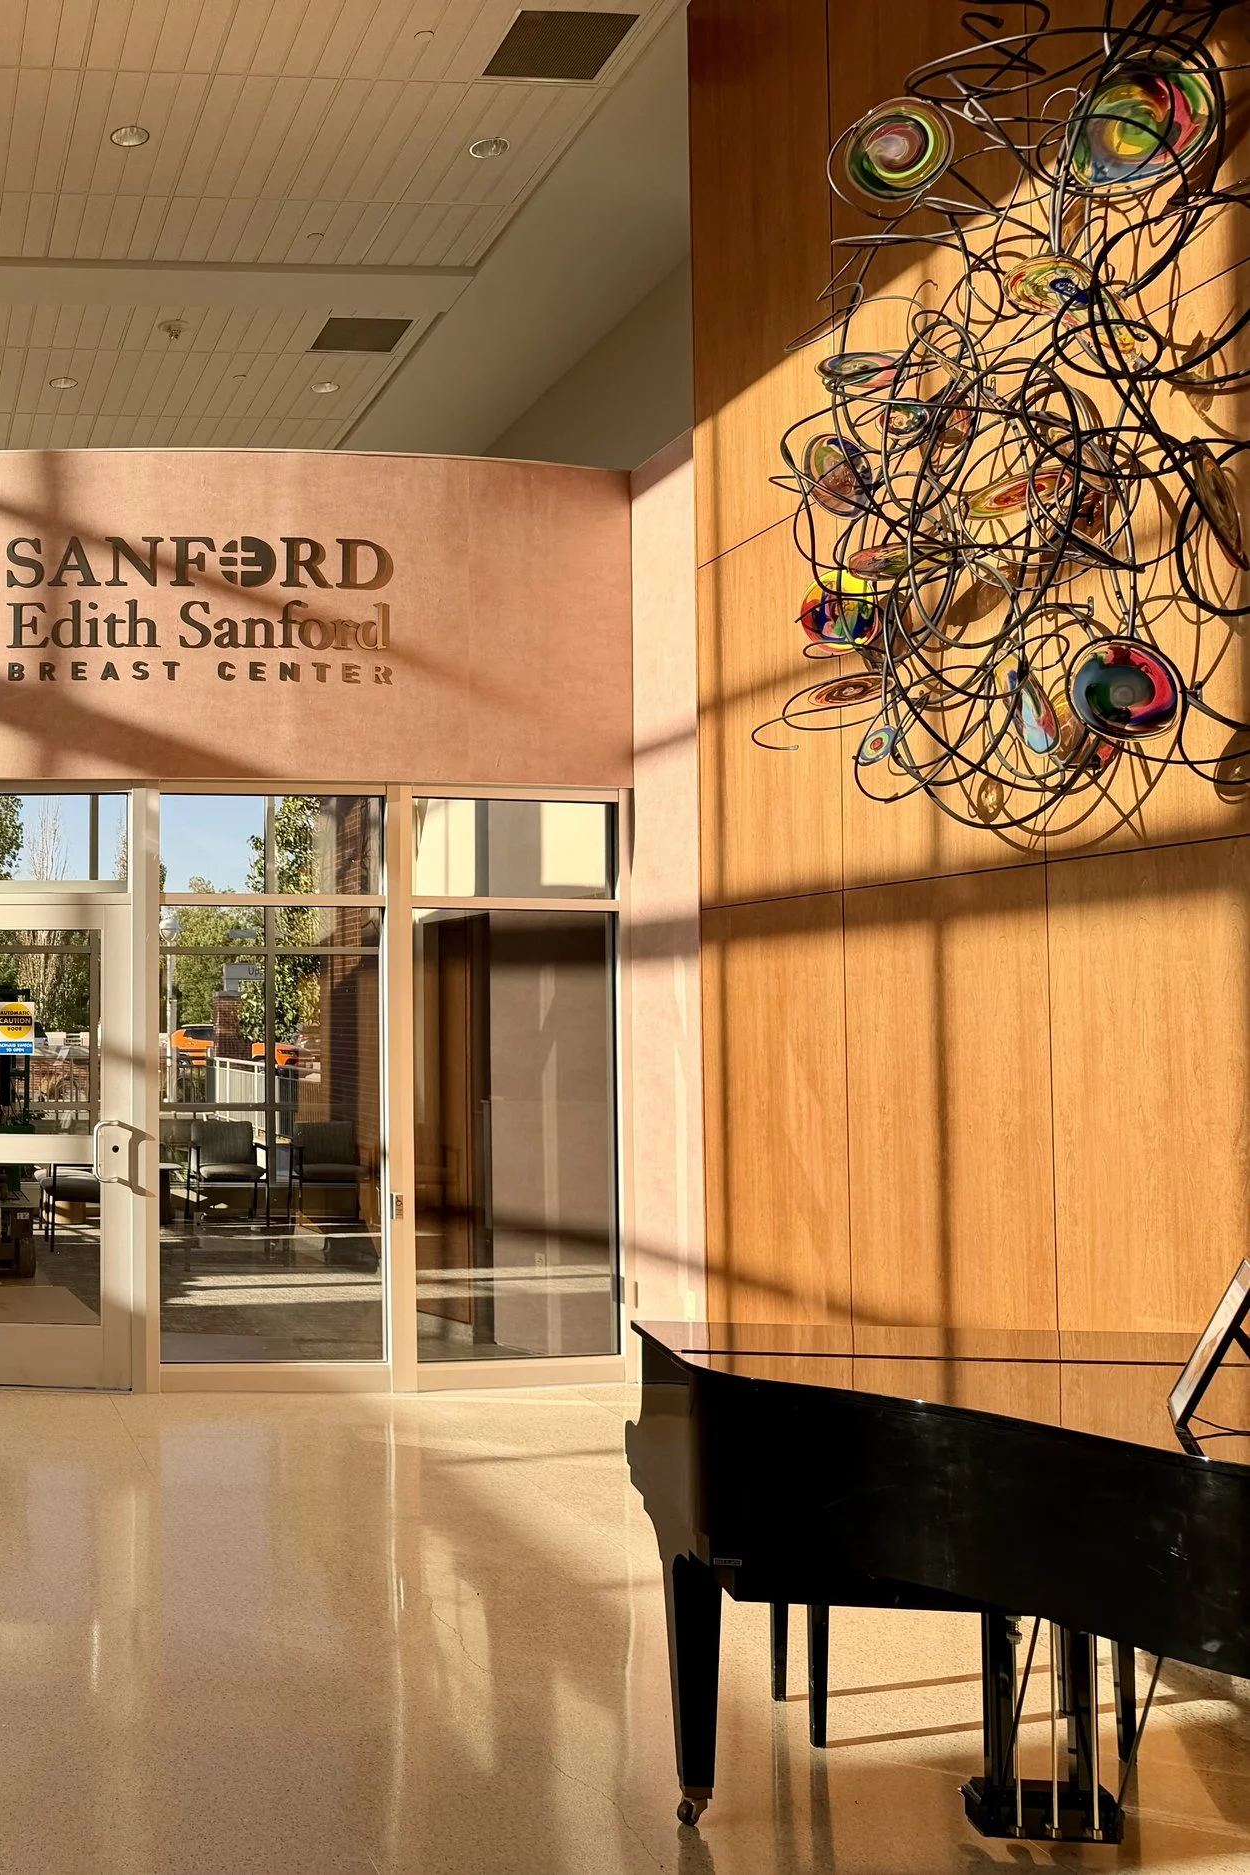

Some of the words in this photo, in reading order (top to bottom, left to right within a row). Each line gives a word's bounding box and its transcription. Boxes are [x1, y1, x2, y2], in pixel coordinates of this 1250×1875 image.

[6, 536, 394, 591] SANFORD
[6, 599, 161, 648] Edith
[179, 600, 390, 651] Sanford
[8, 661, 180, 681] BREAST
[217, 661, 393, 685] CENTER
